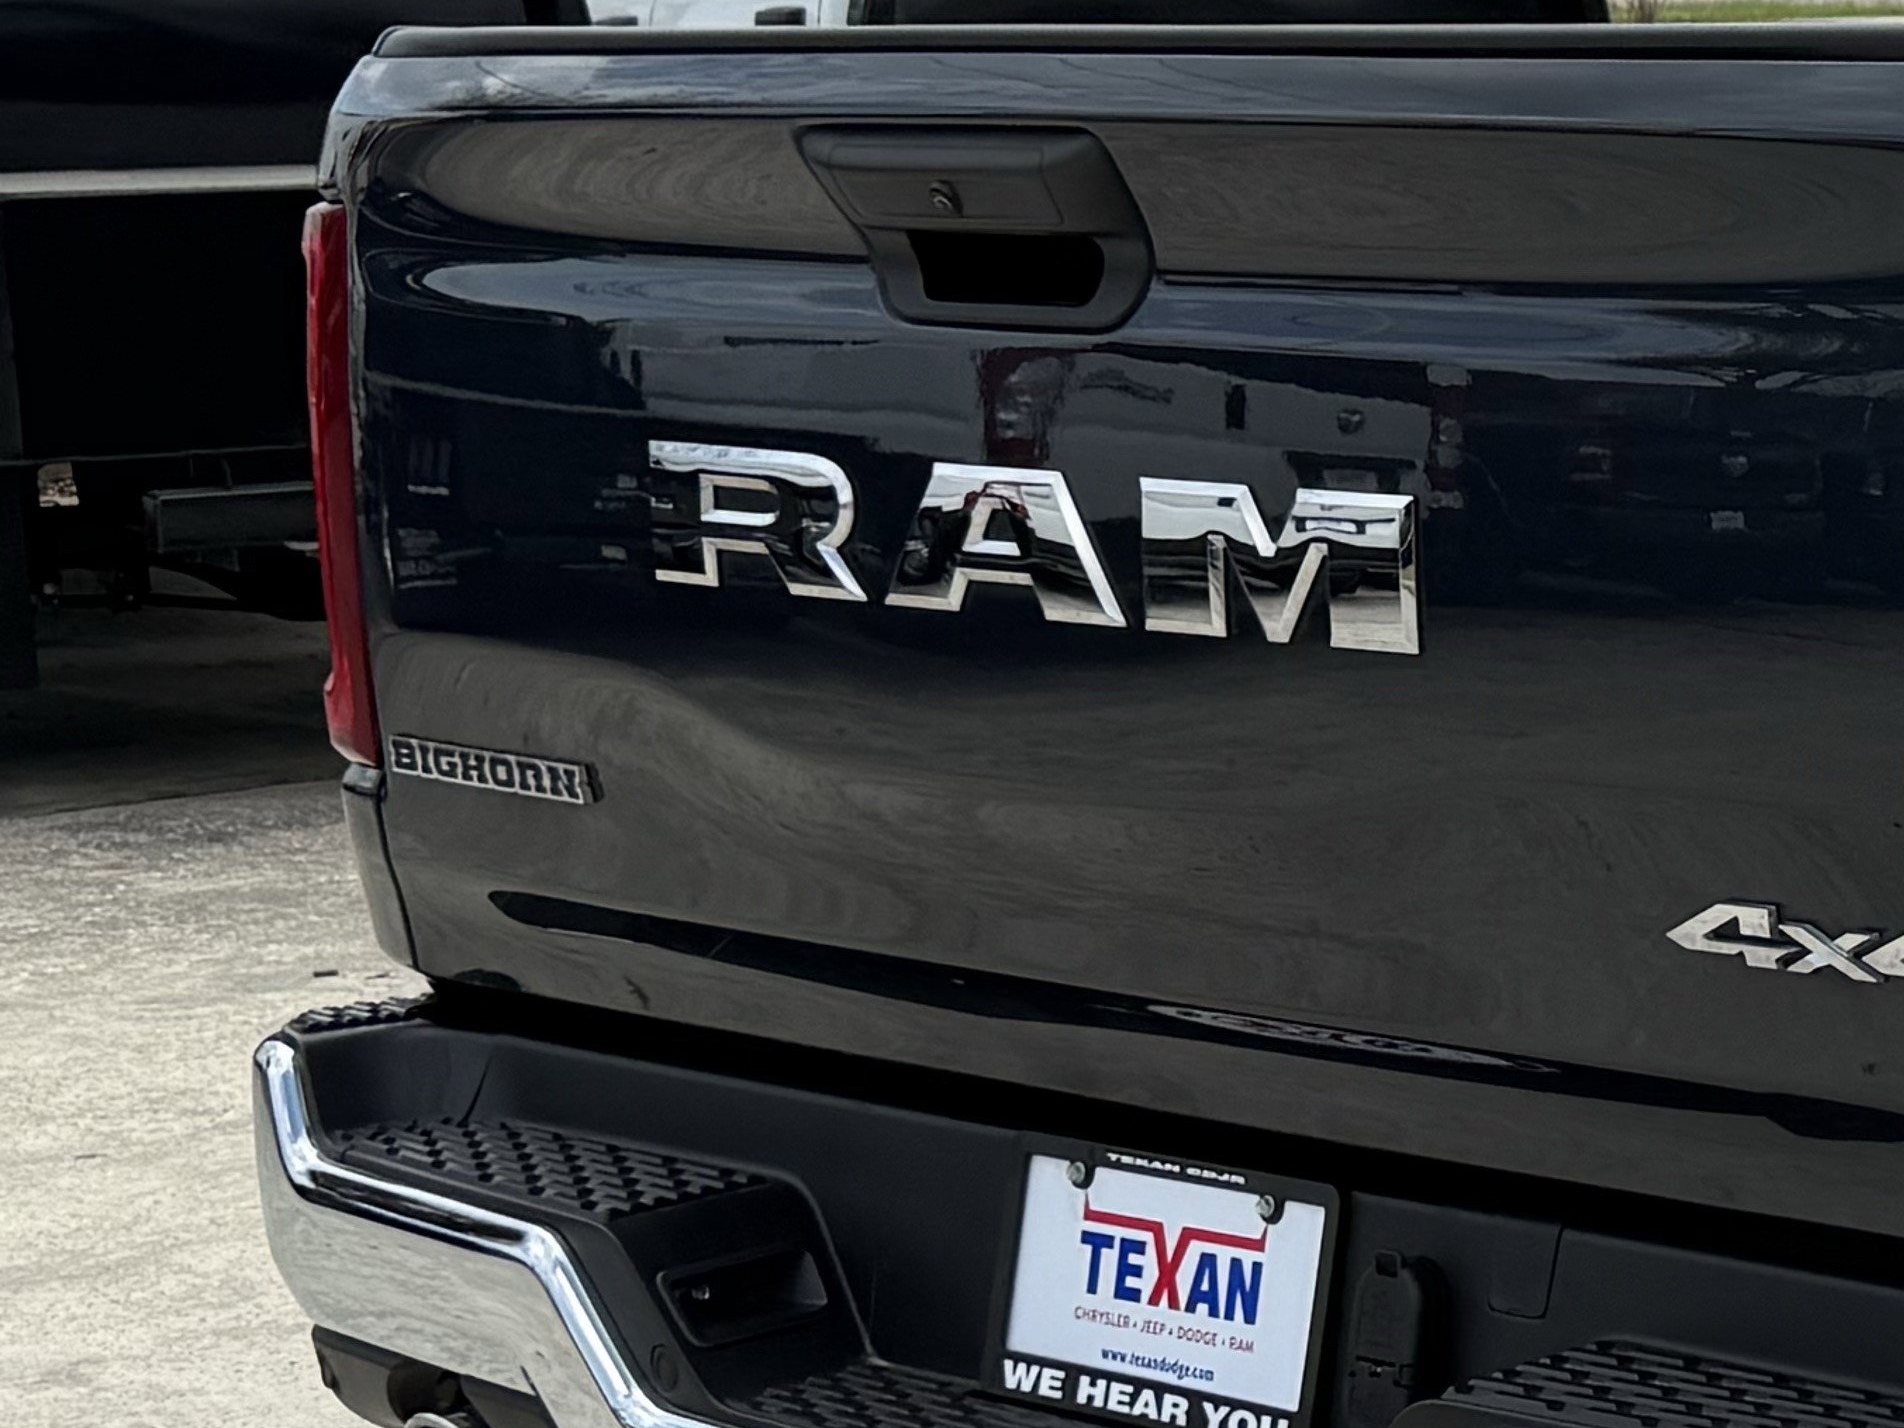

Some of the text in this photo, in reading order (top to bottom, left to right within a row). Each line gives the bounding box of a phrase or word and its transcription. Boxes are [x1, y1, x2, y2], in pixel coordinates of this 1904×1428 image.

[648, 439, 1421, 655] RAM
[389, 735, 586, 805] BIGHORN
[1080, 1206, 1268, 1326] TEXAN
[1074, 1306, 1255, 1353] CHRYSLER JEEP DODGE RAM
[1003, 1358, 1067, 1399] WE
[1076, 1375, 1190, 1427] HEAR
